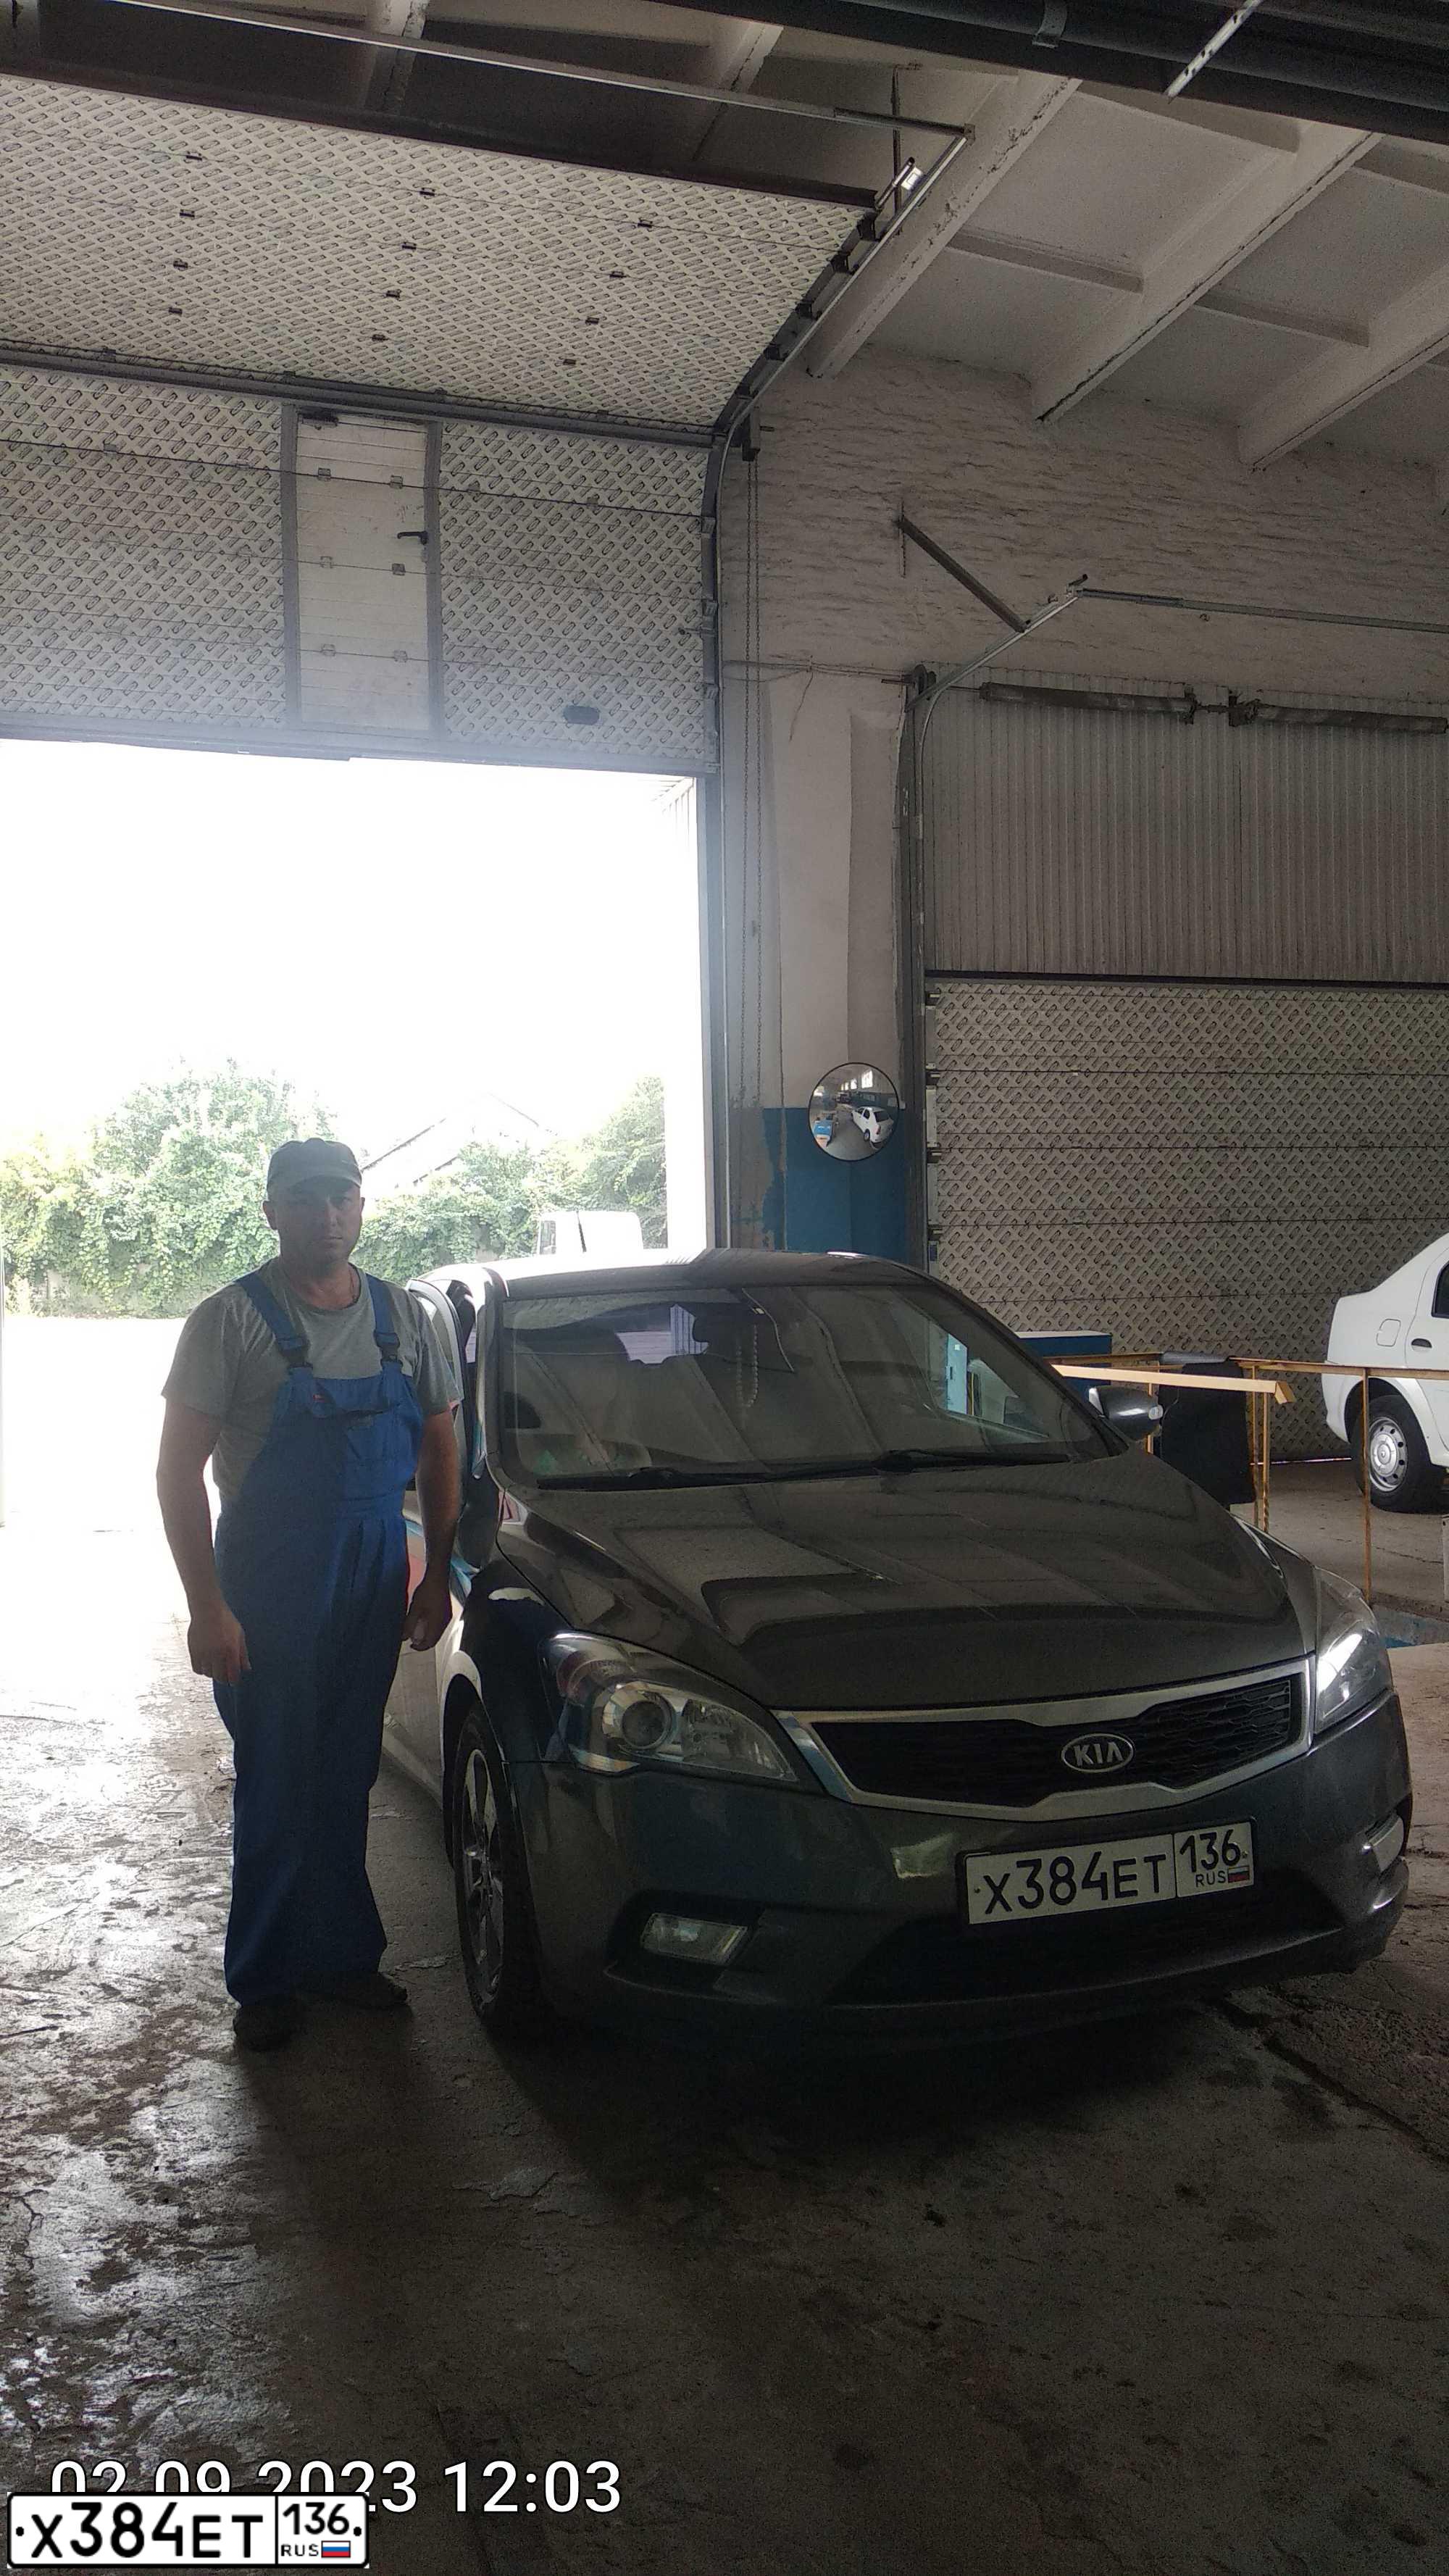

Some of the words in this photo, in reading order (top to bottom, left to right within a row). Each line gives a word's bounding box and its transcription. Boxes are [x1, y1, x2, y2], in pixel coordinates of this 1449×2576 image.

[1074, 1741, 1124, 1767] KIA
[1179, 1829, 1241, 1873] 136
[1195, 1870, 1226, 1888] RUS
